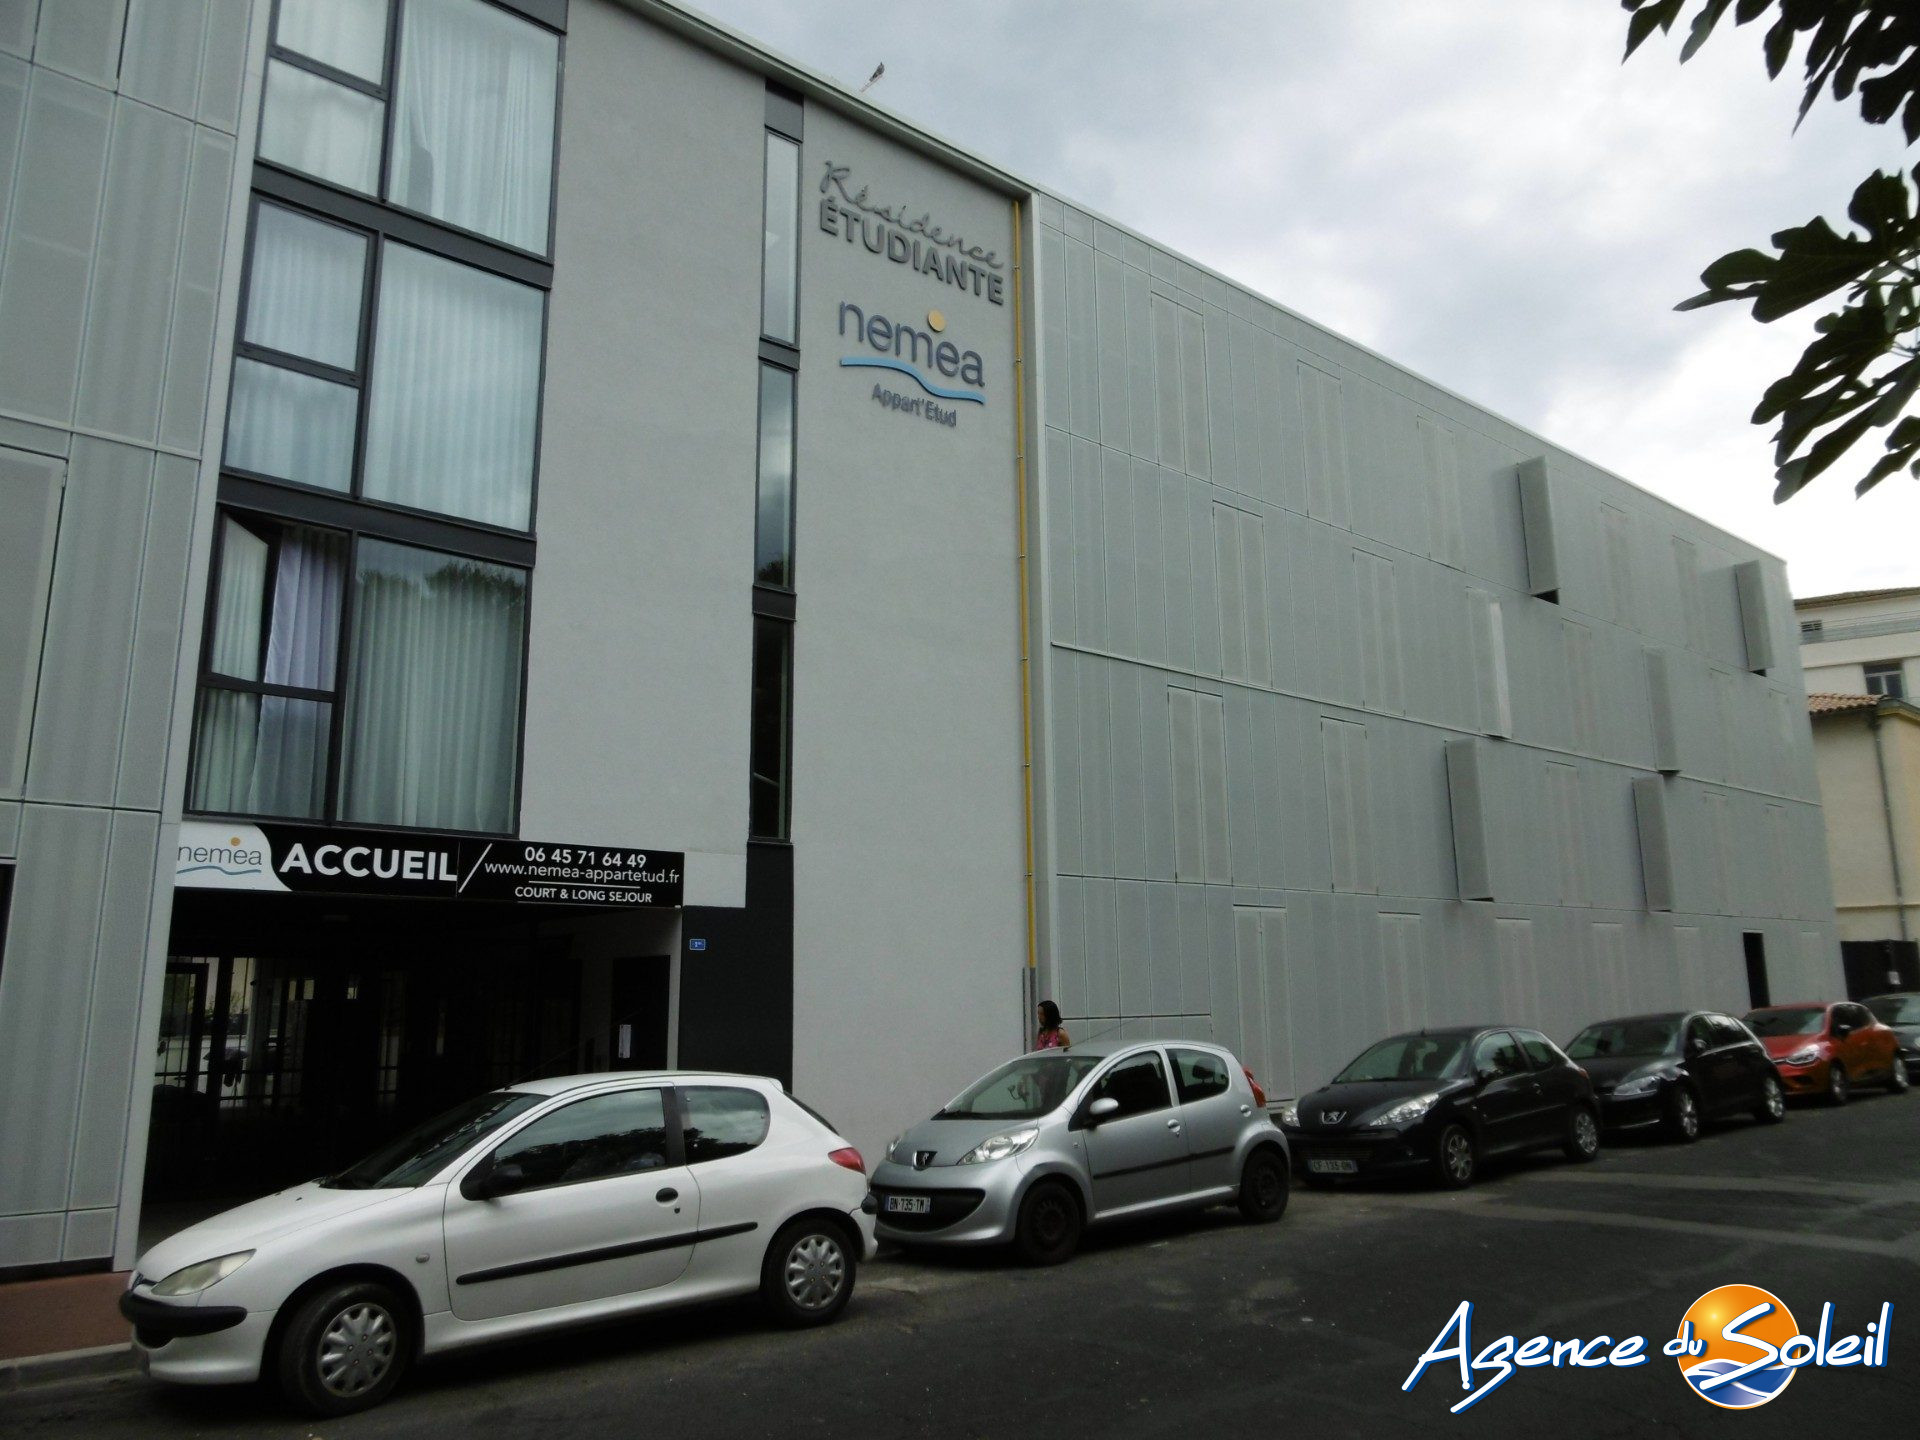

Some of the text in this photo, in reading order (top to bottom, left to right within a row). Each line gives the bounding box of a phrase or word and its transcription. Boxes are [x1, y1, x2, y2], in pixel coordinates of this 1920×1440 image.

[820, 160, 1004, 268] Résidence
[820, 197, 1004, 305] ÉTUDIANTE
[839, 301, 985, 387] nemea
[177, 846, 262, 866] nemea
[279, 843, 457, 882] ACCUEIL
[525, 847, 647, 868] 06 45 71 64 49
[485, 861, 679, 883] www.nemea-appartetud.fr
[515, 887, 652, 903] COURT & LONG SEJOUR
